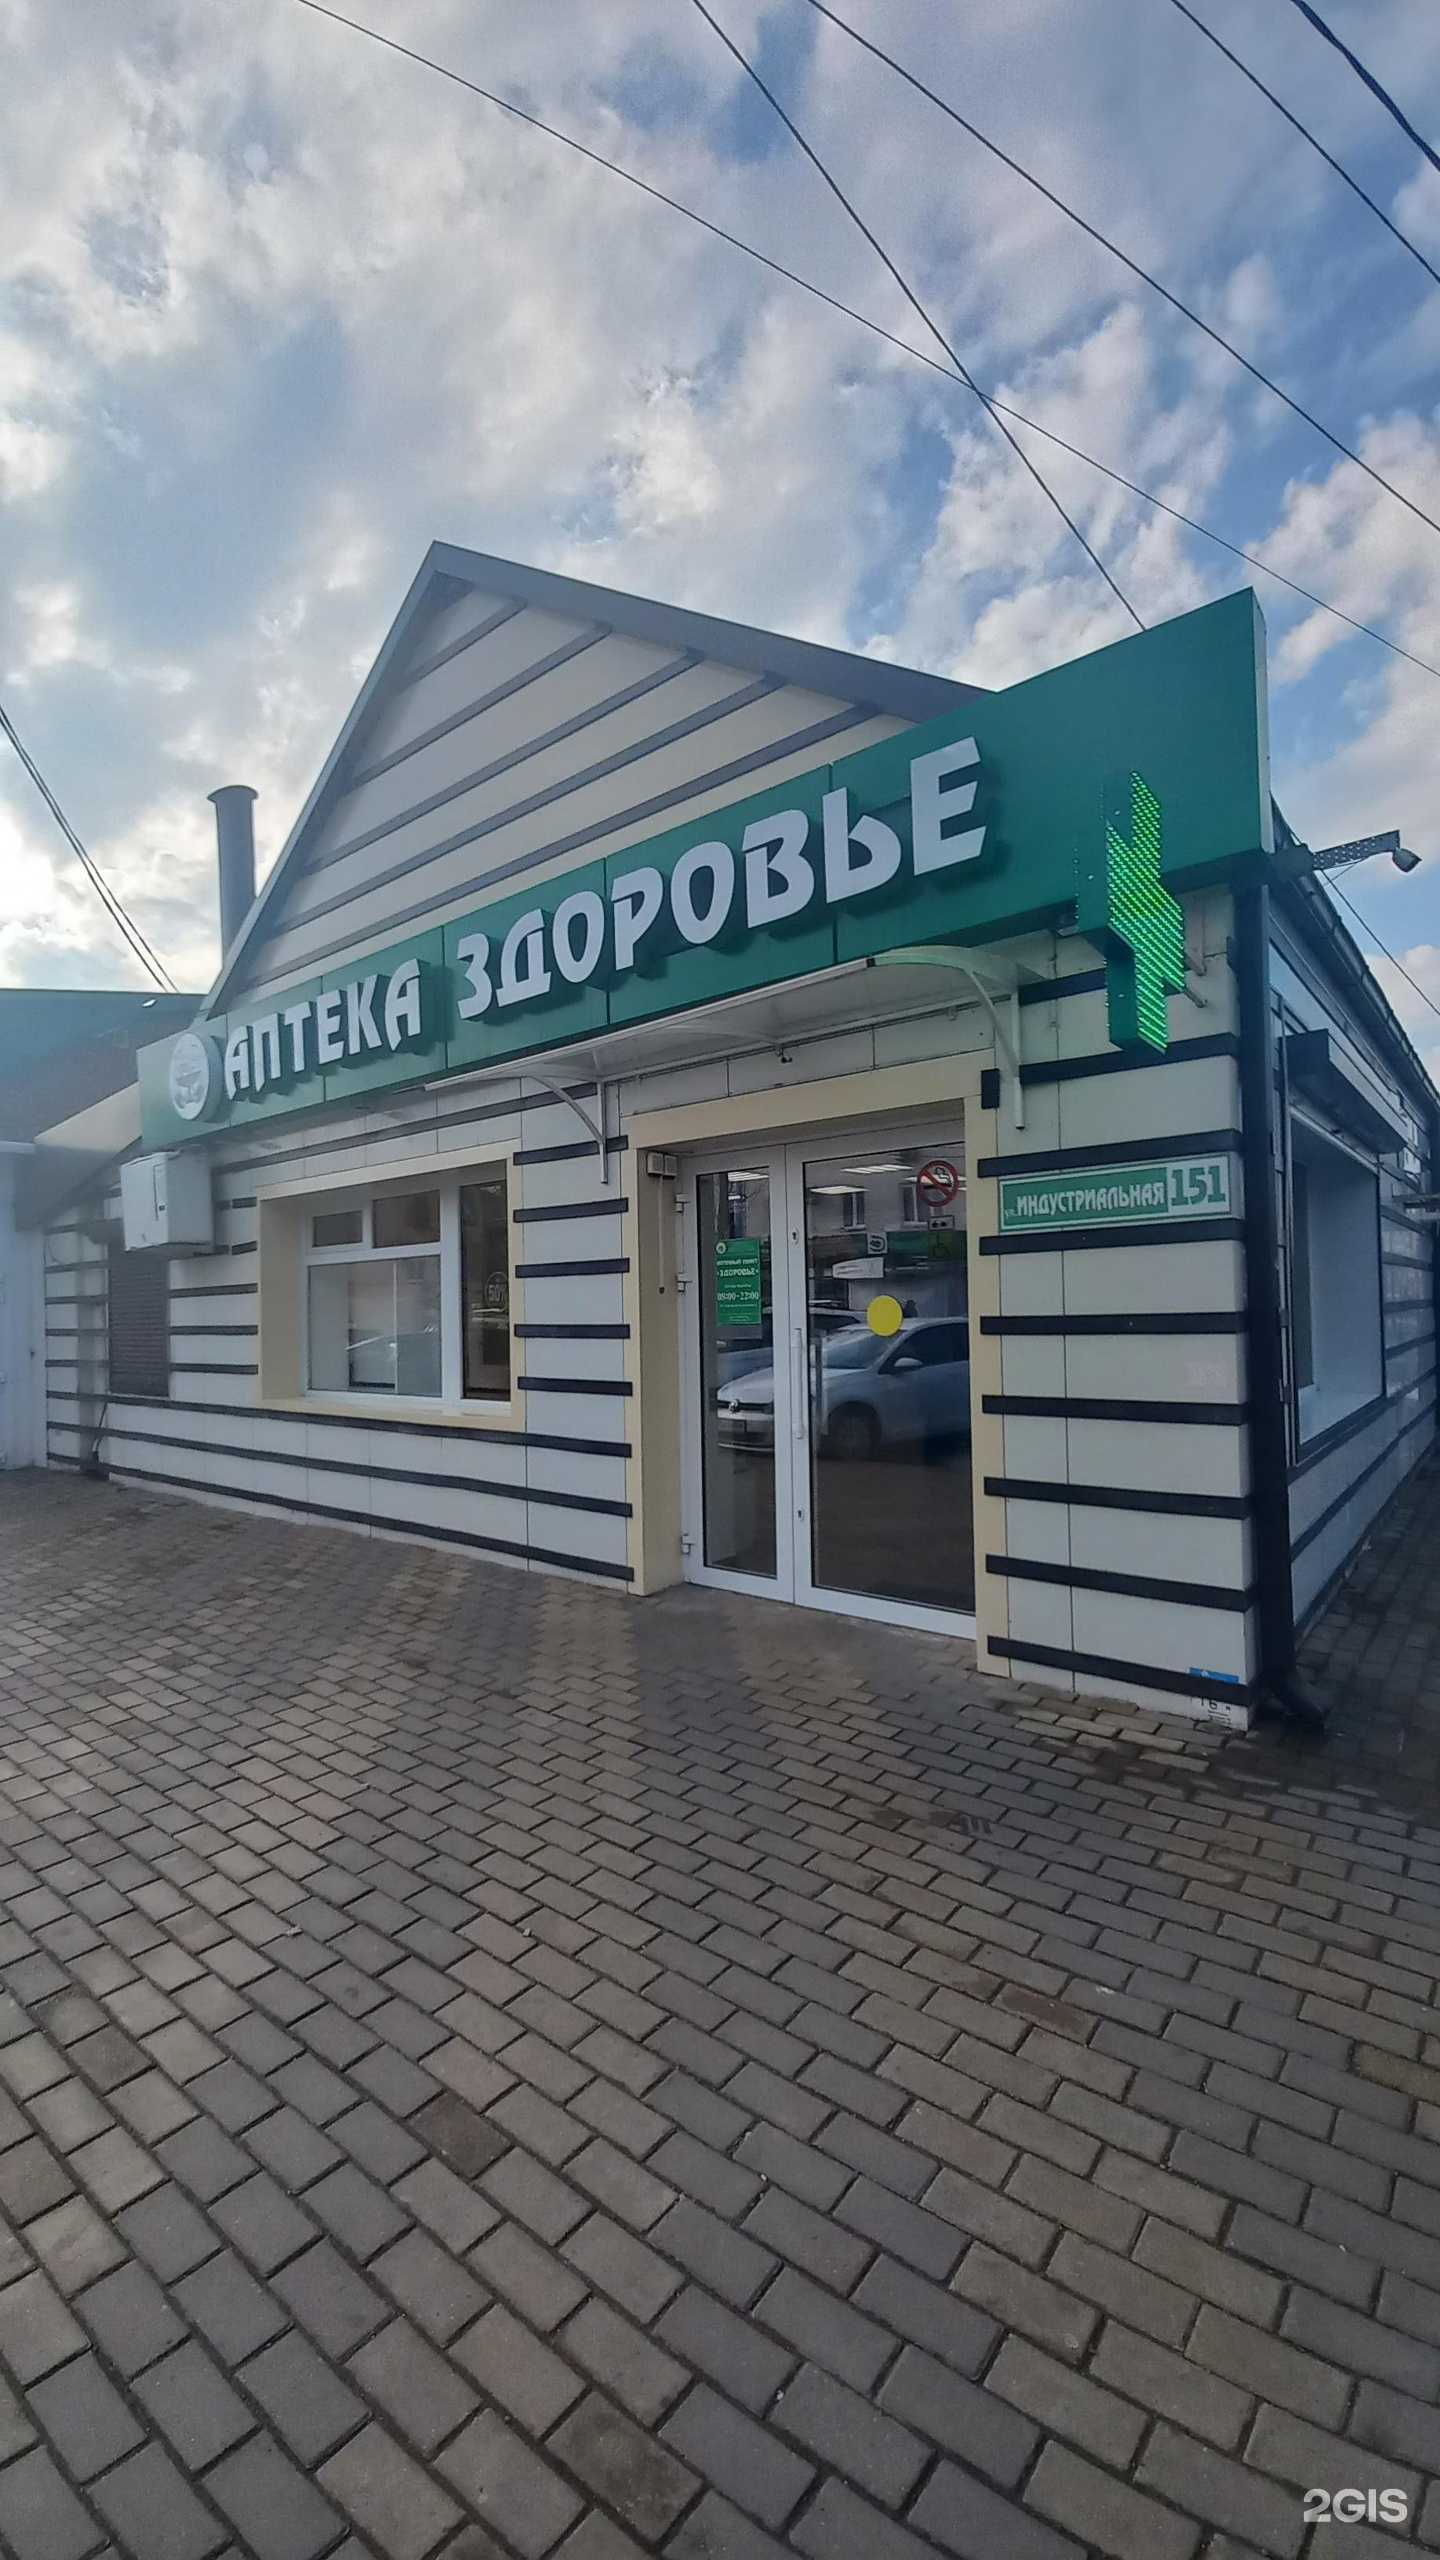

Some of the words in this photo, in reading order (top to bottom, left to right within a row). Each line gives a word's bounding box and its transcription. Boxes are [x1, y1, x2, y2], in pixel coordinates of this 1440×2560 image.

[224, 958, 421, 1100] АПТЕКА
[457, 736, 988, 1020] ЗДОРОВЬЕ
[1017, 1182, 1165, 1217] ИНДУСТРИАЛЬНАЯ
[1171, 1165, 1227, 1207] 151
